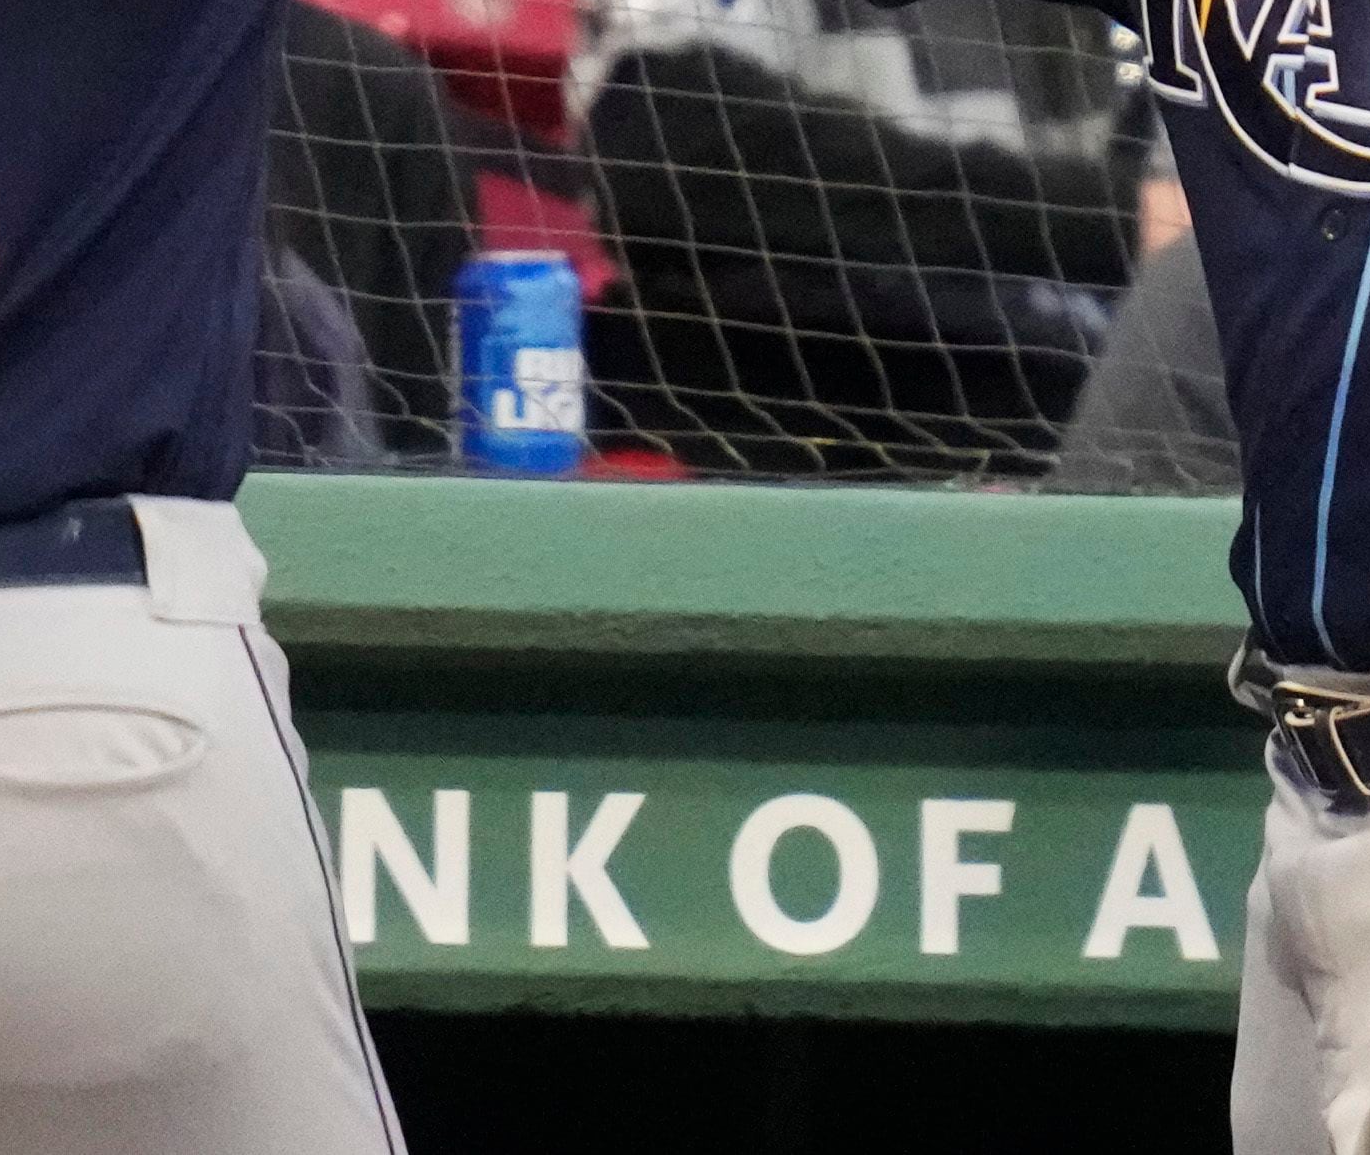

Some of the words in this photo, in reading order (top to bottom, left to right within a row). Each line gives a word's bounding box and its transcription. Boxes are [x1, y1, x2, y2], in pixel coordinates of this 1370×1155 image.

[339, 786, 651, 948] NK
[729, 793, 1017, 956] OF
[1082, 802, 1222, 961] A
